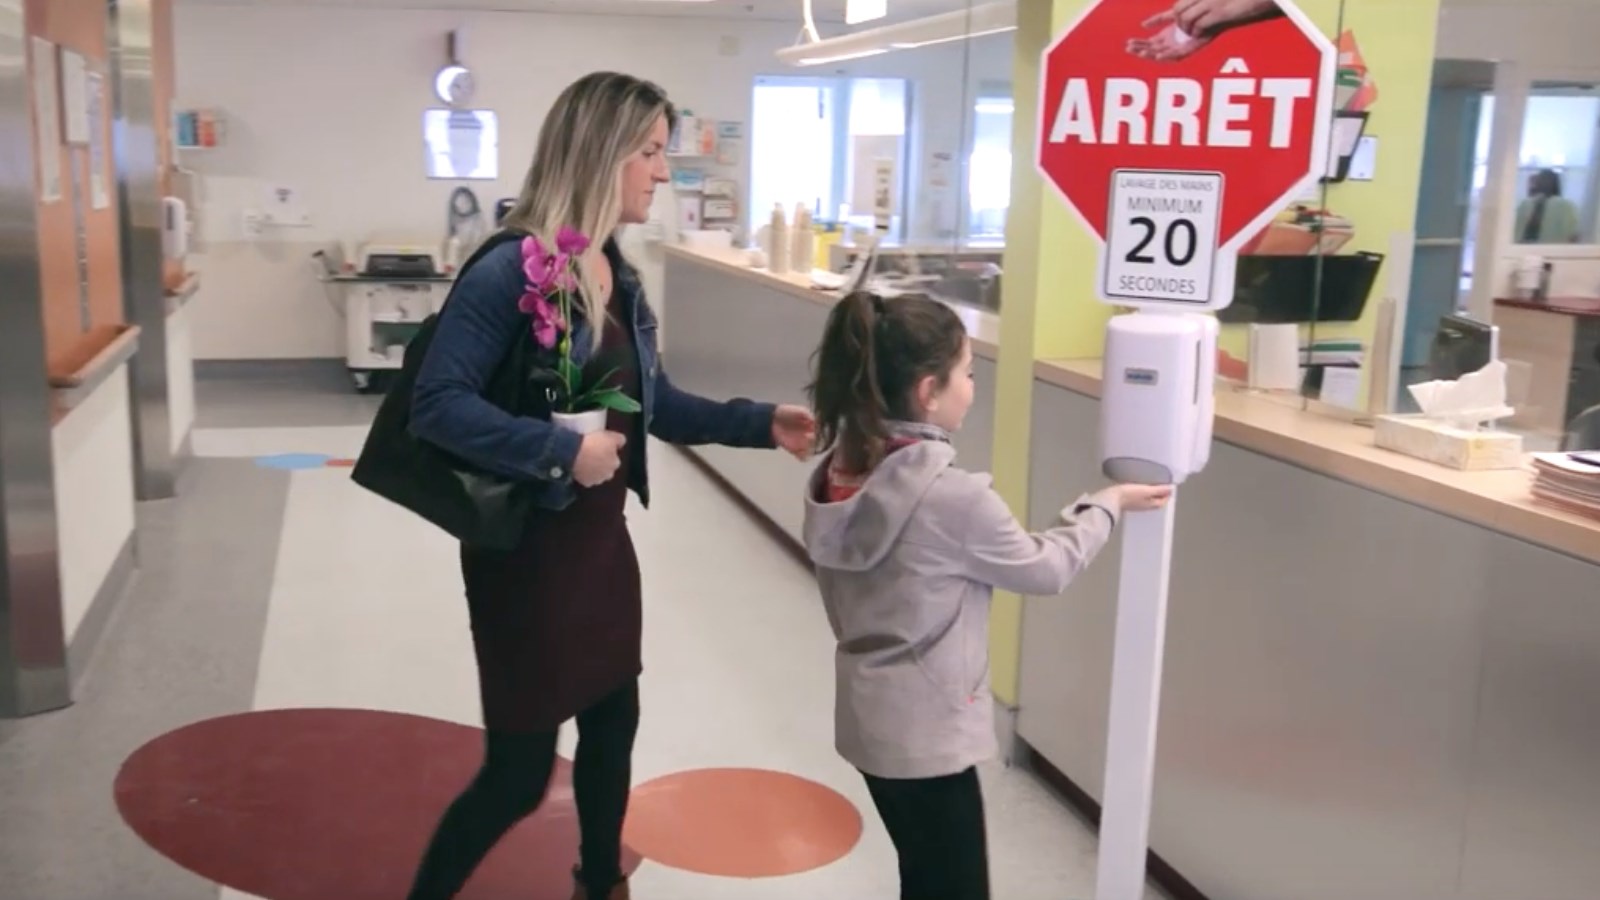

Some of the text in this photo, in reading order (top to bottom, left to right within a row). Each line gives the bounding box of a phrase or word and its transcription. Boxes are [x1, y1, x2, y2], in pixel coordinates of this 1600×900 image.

[1048, 57, 1312, 148] ARRÊT
[1159, 179, 1177, 190] DES
[1128, 196, 1202, 214] MINIMUM
[1124, 216, 1197, 266] 20
[1119, 275, 1196, 295] SECONDES
